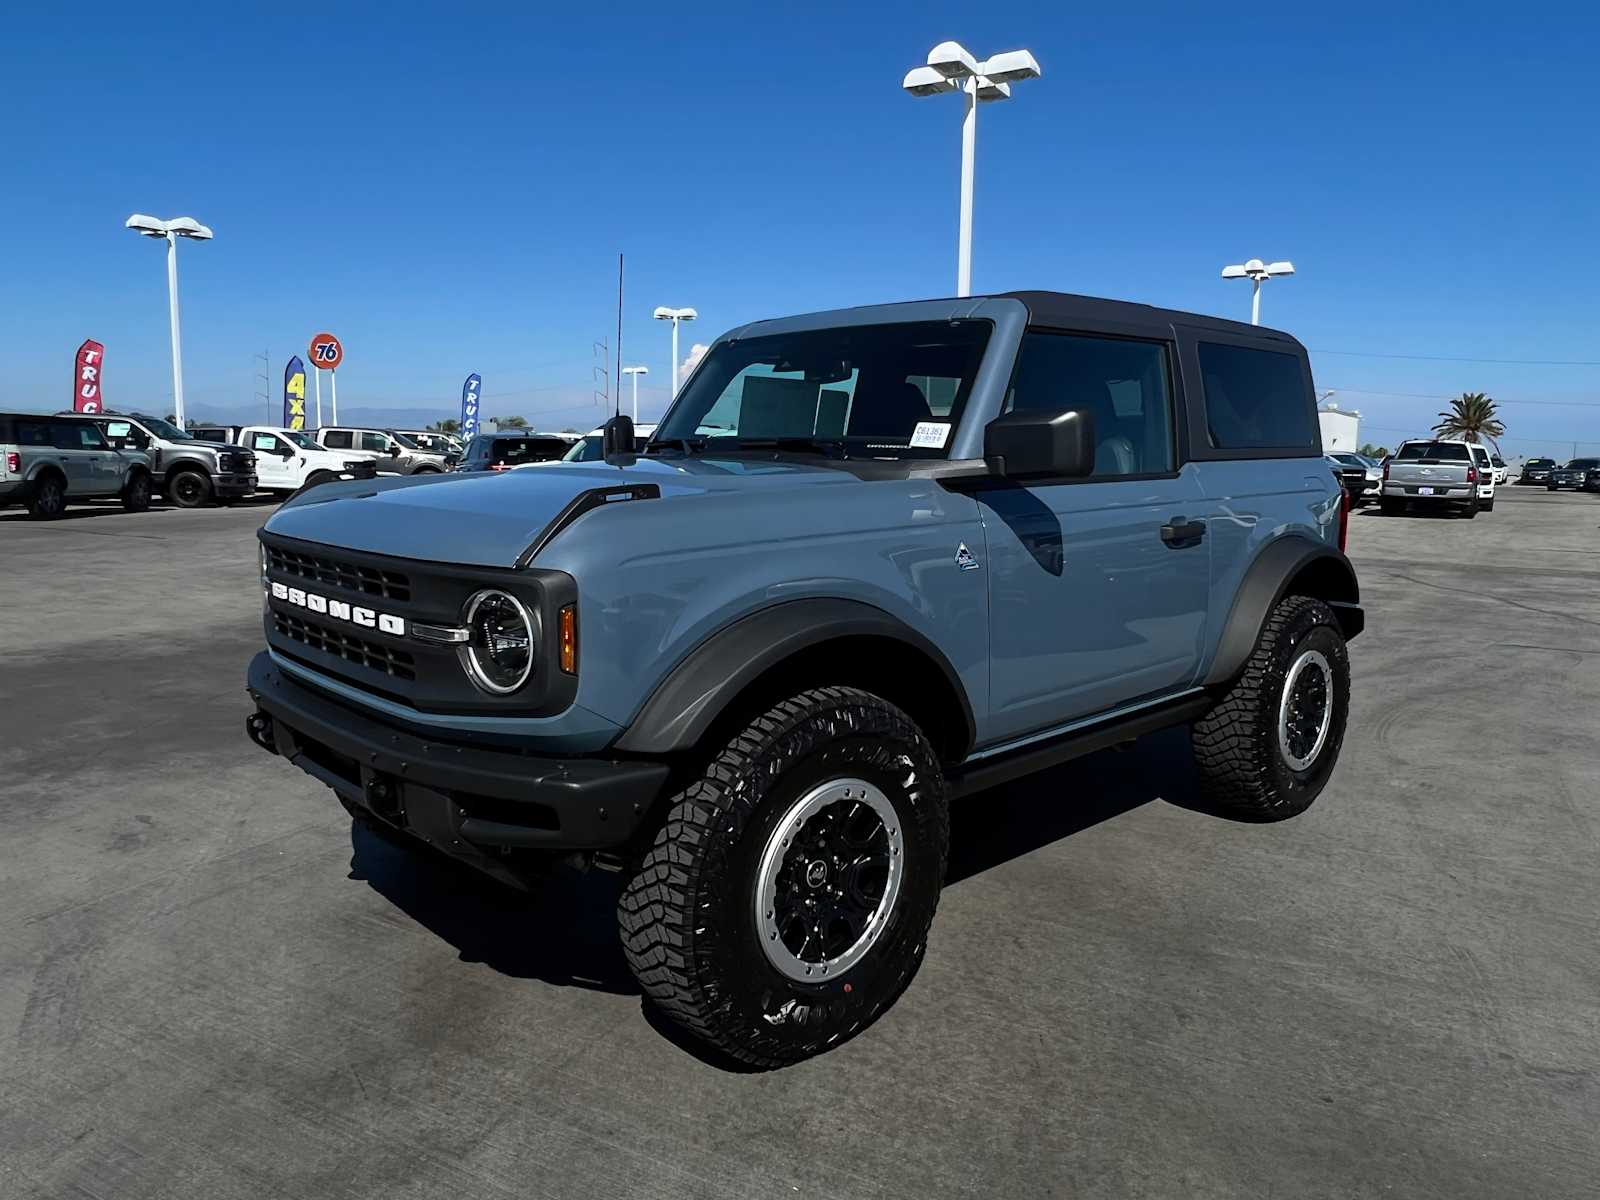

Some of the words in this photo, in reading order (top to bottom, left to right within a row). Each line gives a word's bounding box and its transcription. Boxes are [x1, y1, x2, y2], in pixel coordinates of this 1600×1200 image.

[315, 341, 338, 363] 76
[462, 380, 479, 442] TRUCK
[272, 582, 405, 635] BRONCO
